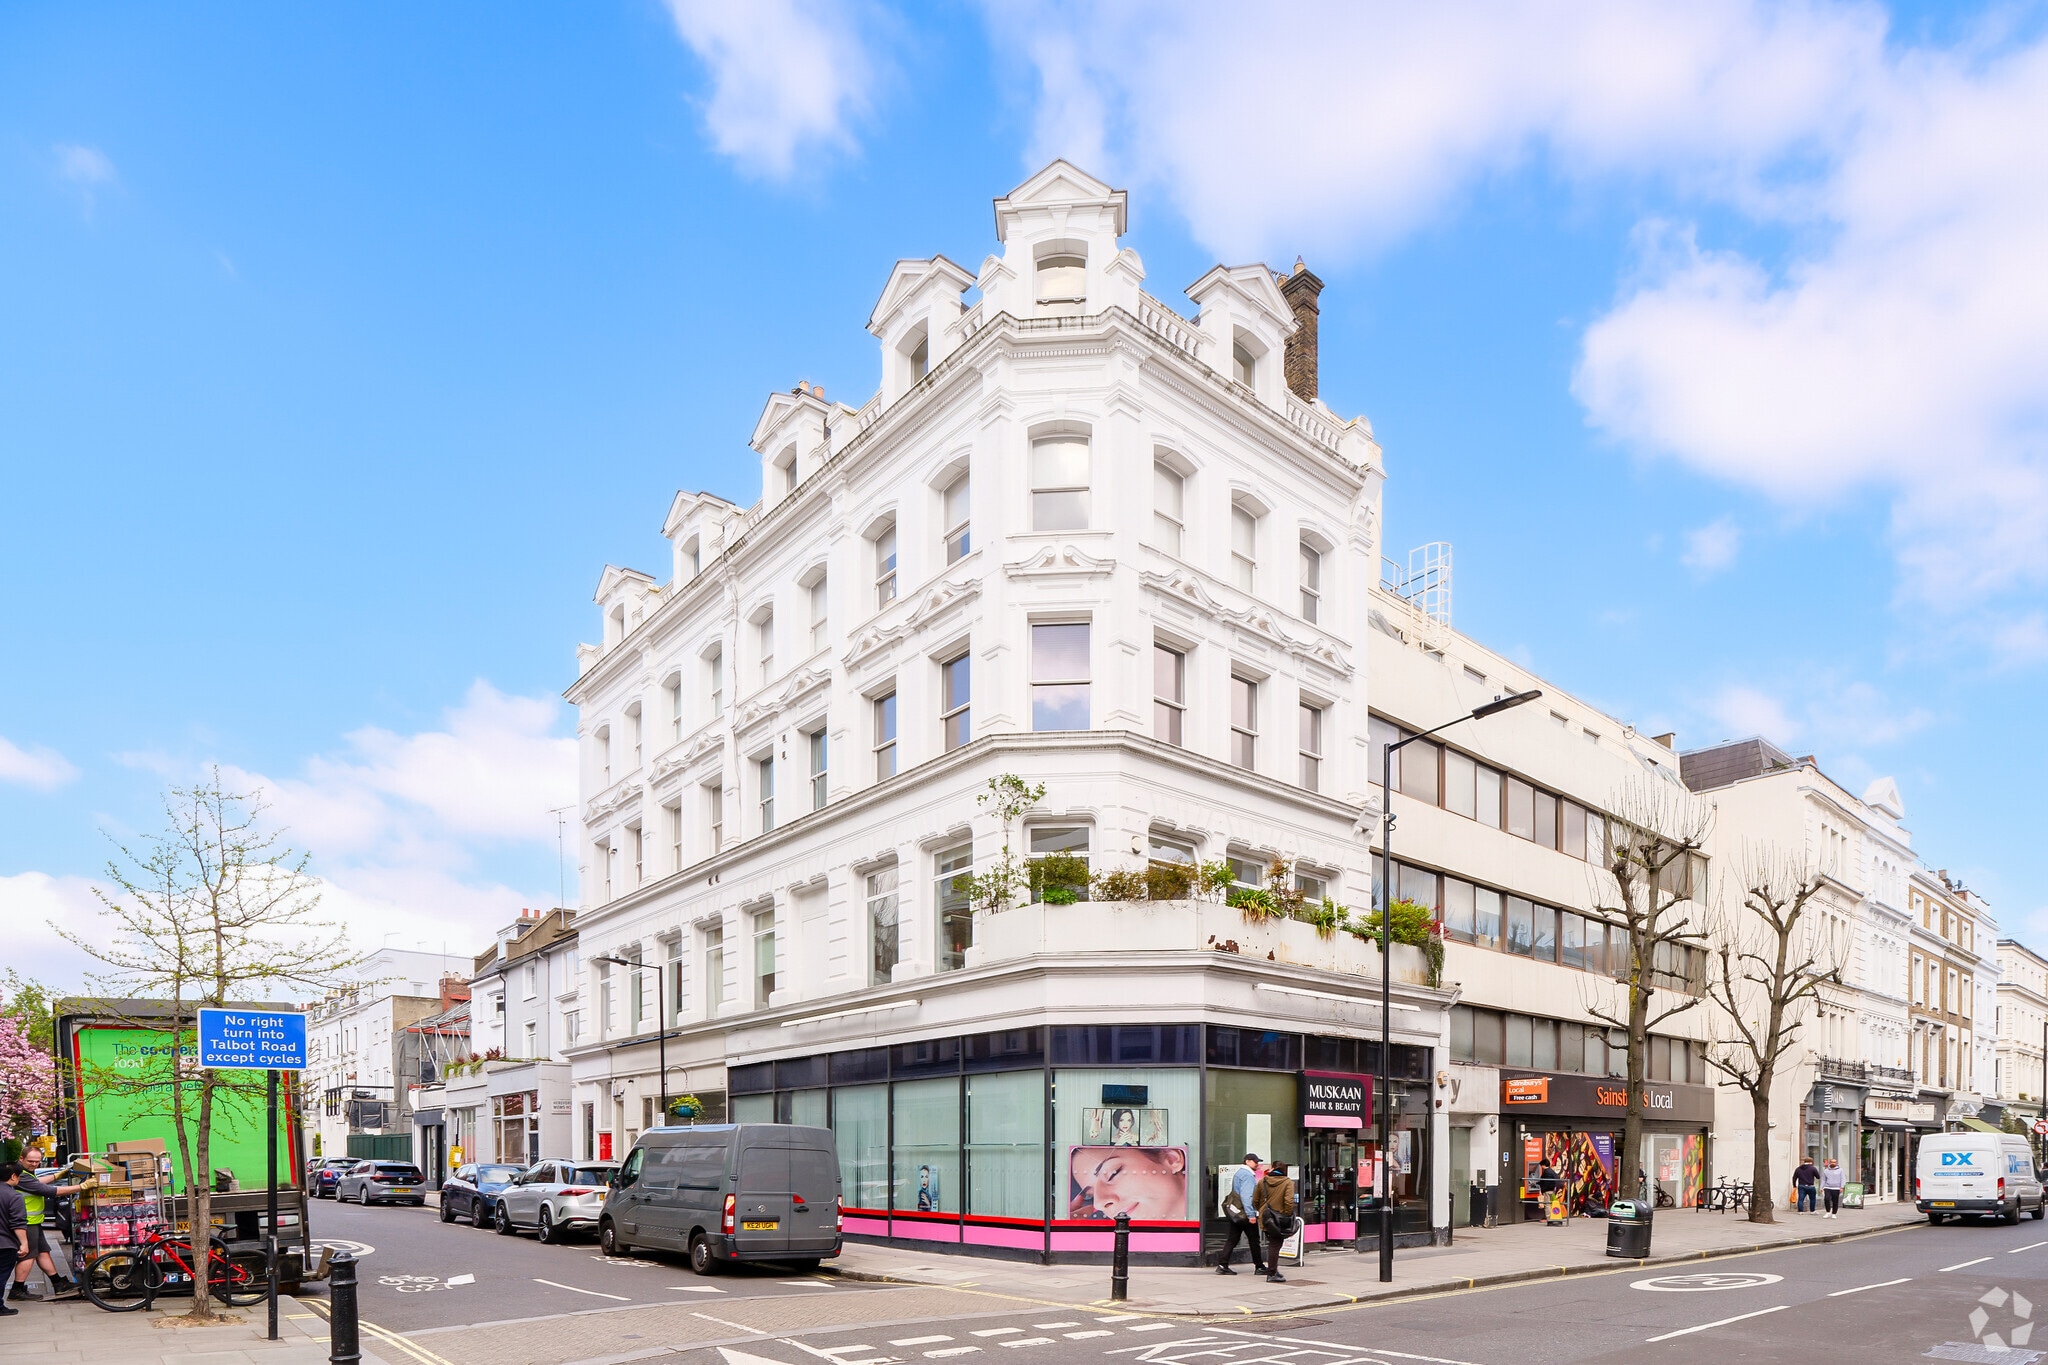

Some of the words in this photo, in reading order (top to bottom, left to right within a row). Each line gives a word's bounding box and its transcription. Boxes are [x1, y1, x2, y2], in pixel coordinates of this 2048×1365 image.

[225, 1015, 246, 1026] No
[251, 1017, 284, 1029] right
[223, 1028, 253, 1039] turn
[258, 1029, 285, 1040] into
[112, 1043, 137, 1056] The
[210, 1039, 256, 1051] Talbot
[261, 1041, 296, 1052] Road
[206, 1053, 255, 1064] except
[259, 1054, 302, 1065] cycles
[1508, 1079, 1543, 1088] Sainsbury's
[1309, 1084, 1362, 1100] MUSKAAN
[1596, 1085, 1649, 1108] Sainsb's
[1650, 1090, 1673, 1109] Local
[1309, 1101, 1327, 1110] HAIR
[1328, 1101, 1334, 1110] &
[1335, 1102, 1361, 1111] BEAUTY
[1941, 1152, 1974, 1166] DX
